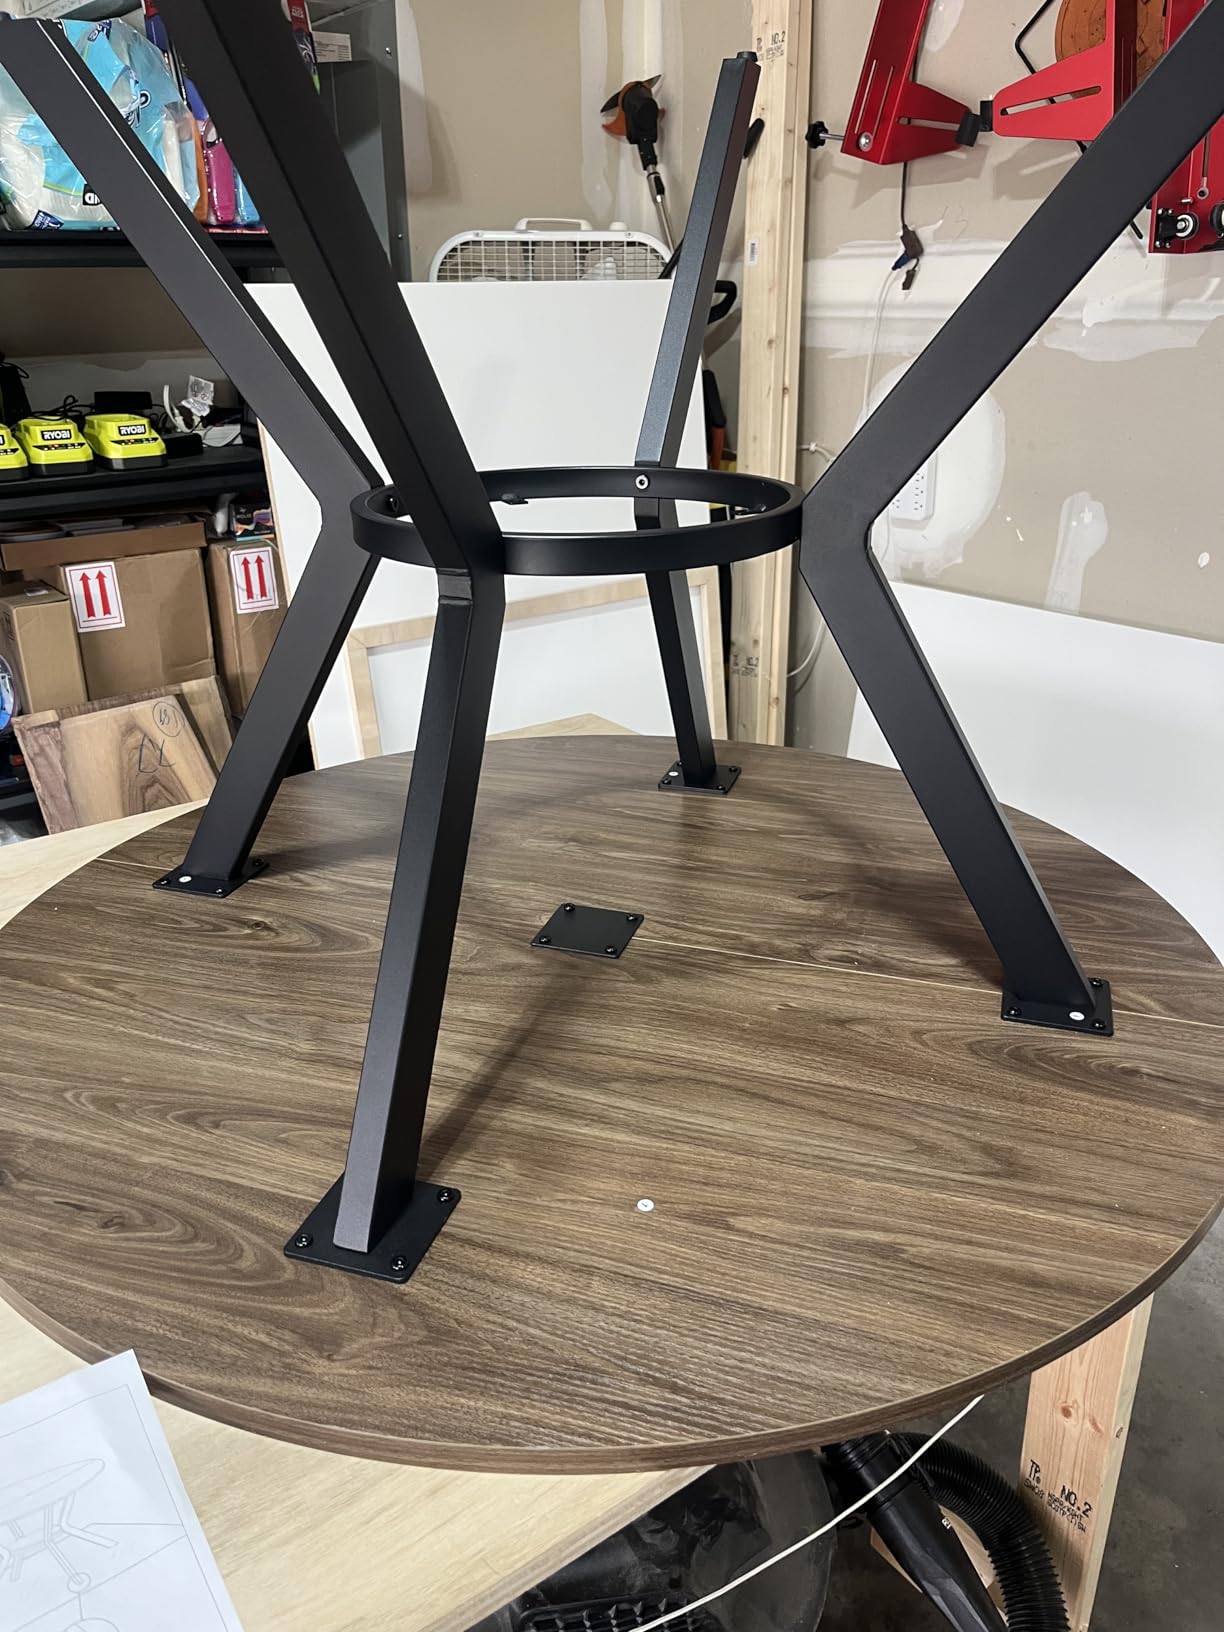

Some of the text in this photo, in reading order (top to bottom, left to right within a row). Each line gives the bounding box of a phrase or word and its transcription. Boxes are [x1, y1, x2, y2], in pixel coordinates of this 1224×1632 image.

[42, 430, 71, 440] RYOBI
[119, 424, 146, 435] RYOBI
[1060, 1484, 1093, 1518] NO.2
